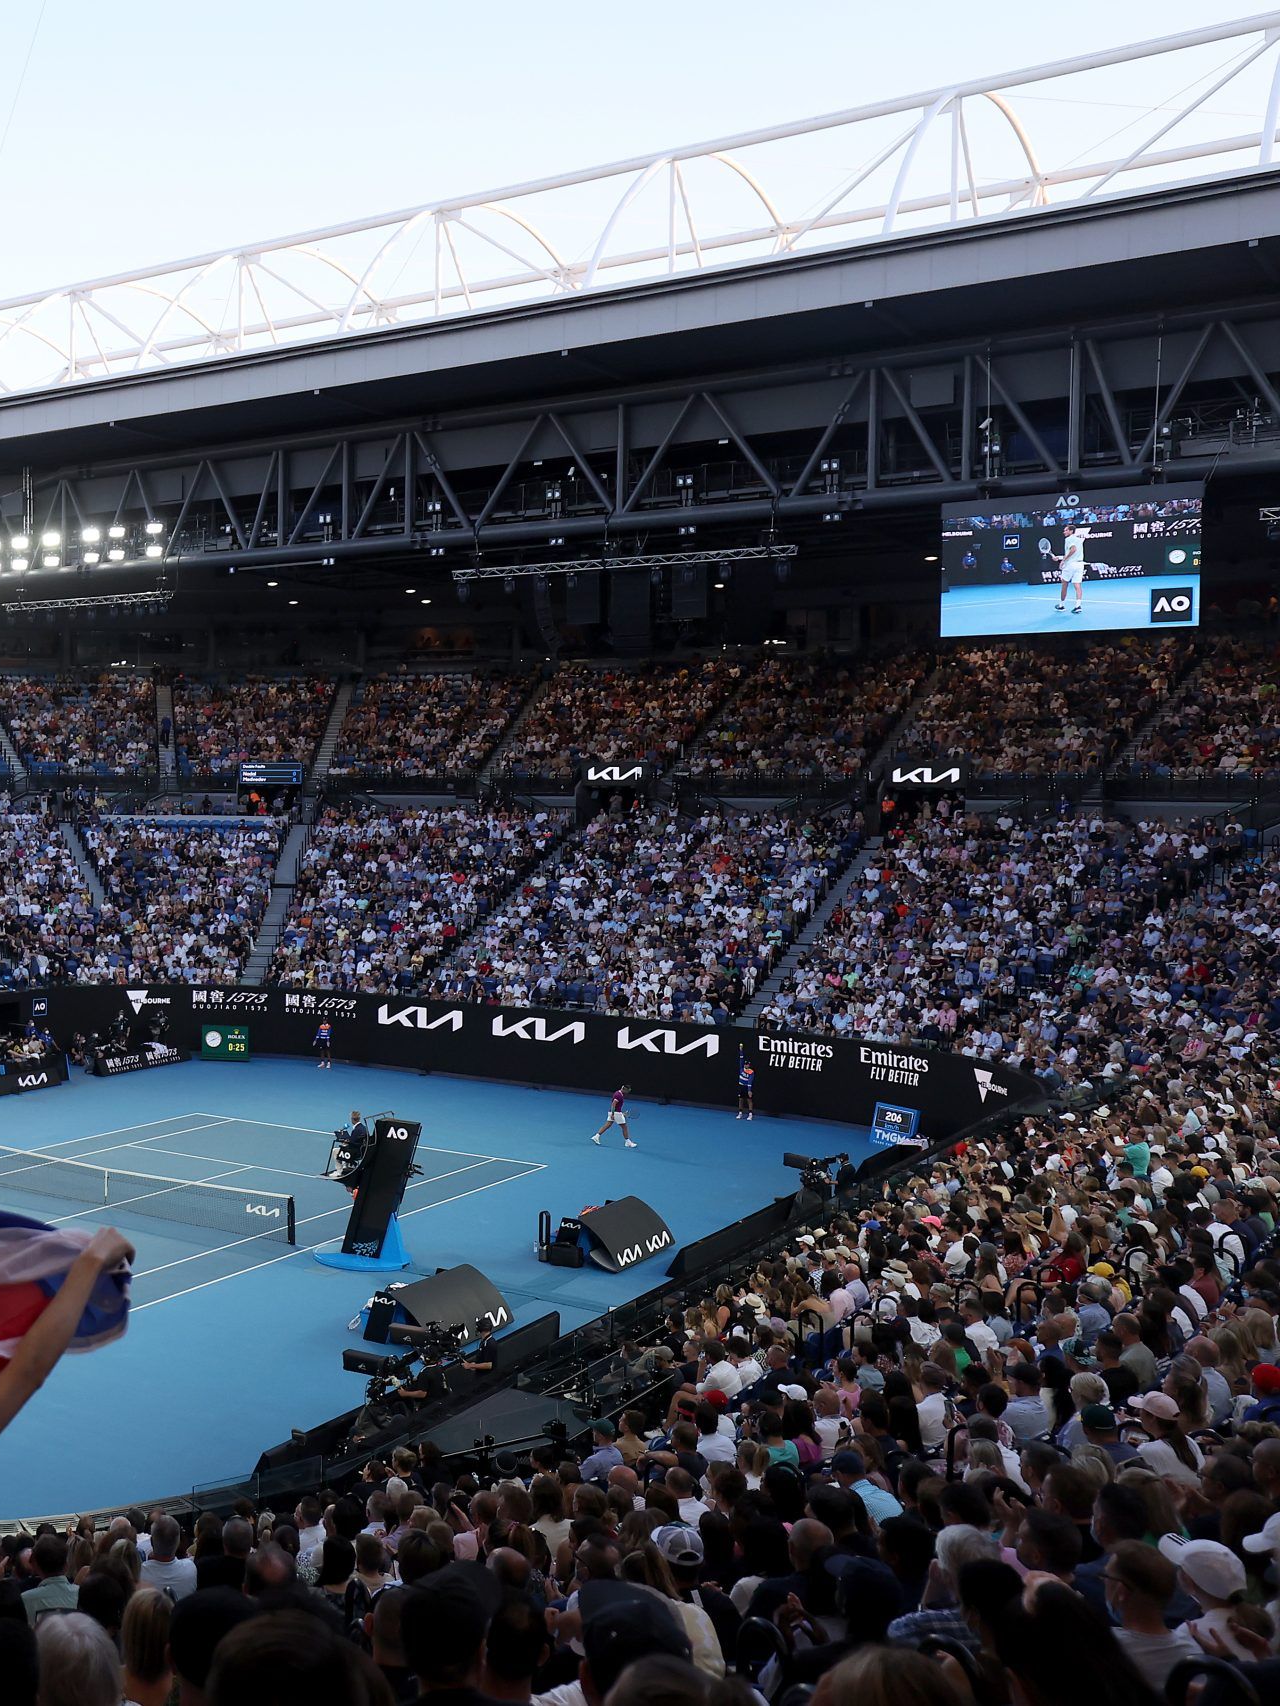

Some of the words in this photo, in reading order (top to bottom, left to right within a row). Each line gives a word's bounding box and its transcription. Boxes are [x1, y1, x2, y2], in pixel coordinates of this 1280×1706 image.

[1055, 494, 1080, 507] AO
[1153, 595, 1191, 613] AO
[587, 766, 643, 781] KIA
[892, 767, 960, 783] KIA
[34, 1002, 46, 1011] AO
[377, 1003, 463, 1031] KIA
[492, 1014, 585, 1044] KIA
[228, 1043, 245, 1051] 0:25
[617, 1026, 719, 1058] KIA
[758, 1035, 833, 1059] Emirates
[769, 1053, 786, 1068] FLY
[788, 1055, 822, 1072] BETTER
[859, 1046, 929, 1073] Emirates
[17, 1072, 48, 1087] KIA
[870, 1066, 887, 1081] FLY
[888, 1069, 919, 1087] BETTER
[885, 1111, 902, 1123] 206
[387, 1126, 408, 1140] AO
[339, 1150, 350, 1160] AO
[246, 1203, 280, 1218] KIA
[562, 1222, 582, 1230] KIA
[645, 1230, 670, 1253] KIA
[616, 1243, 642, 1267] KIA
